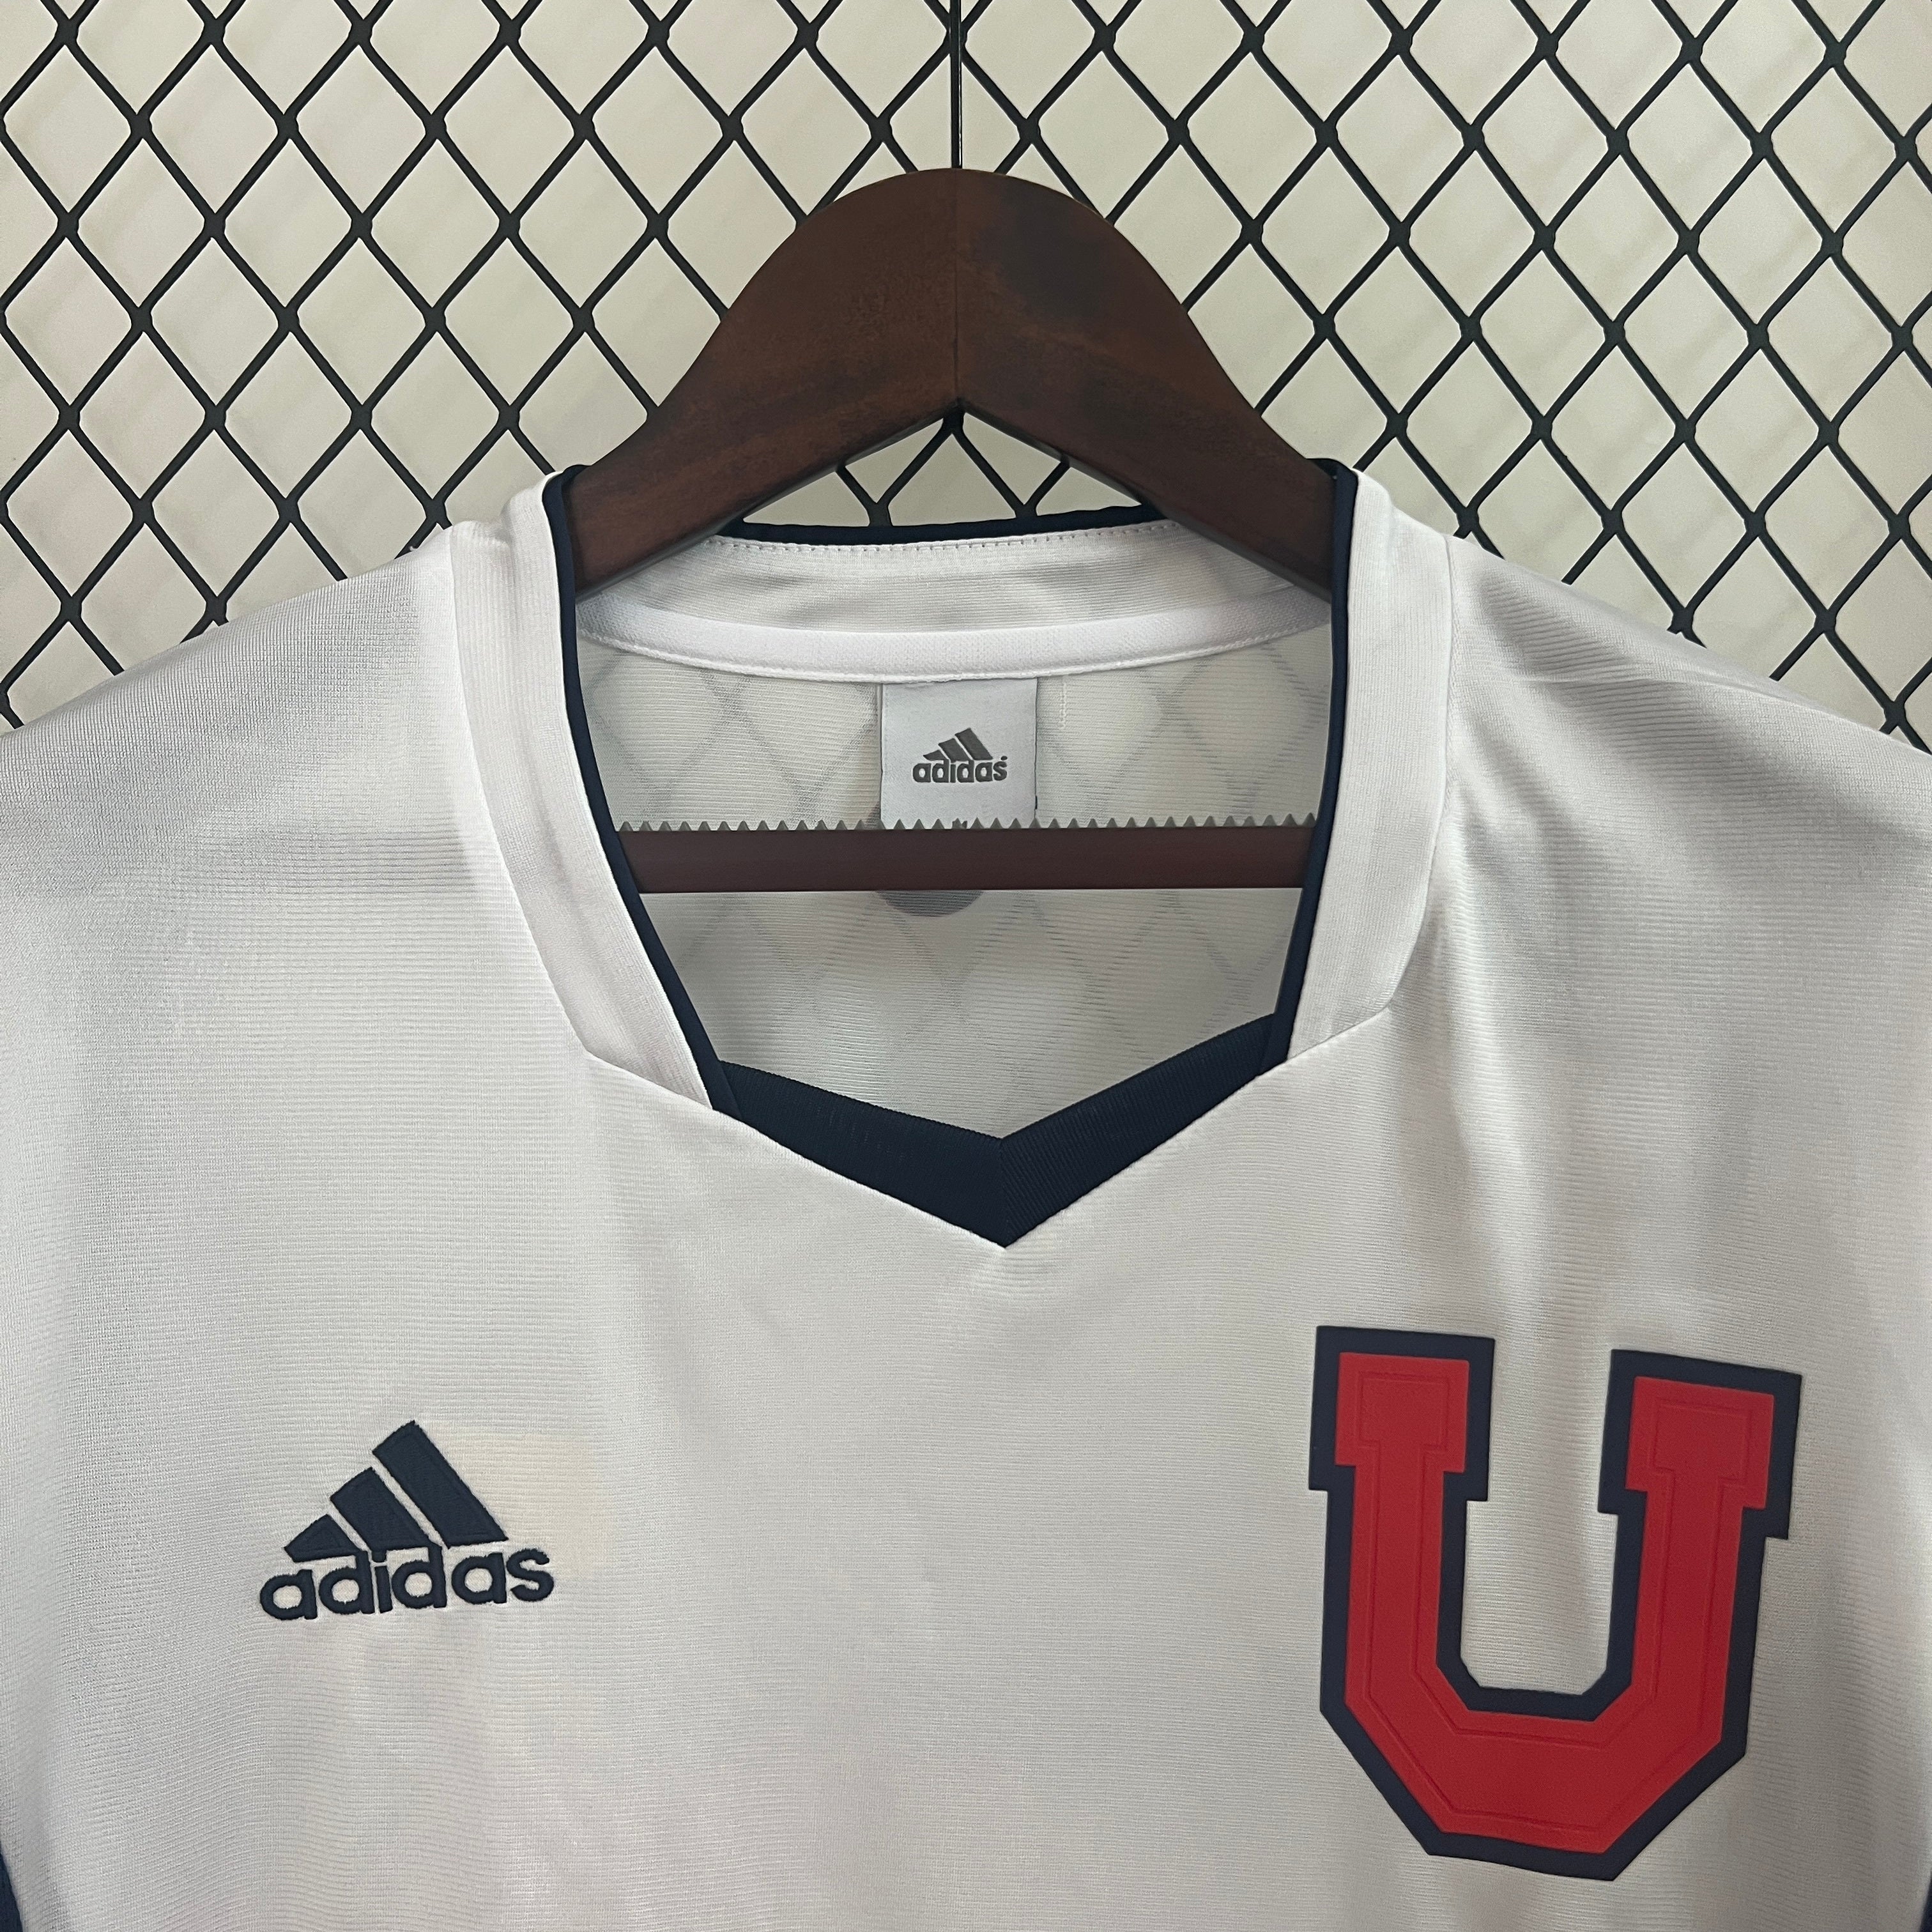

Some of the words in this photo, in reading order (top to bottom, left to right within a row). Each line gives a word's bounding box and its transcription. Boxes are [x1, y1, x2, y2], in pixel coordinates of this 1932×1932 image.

[912, 759, 1008, 783] adidas
[259, 1547, 555, 1620] adidas
[1308, 1326, 1802, 1882] U
